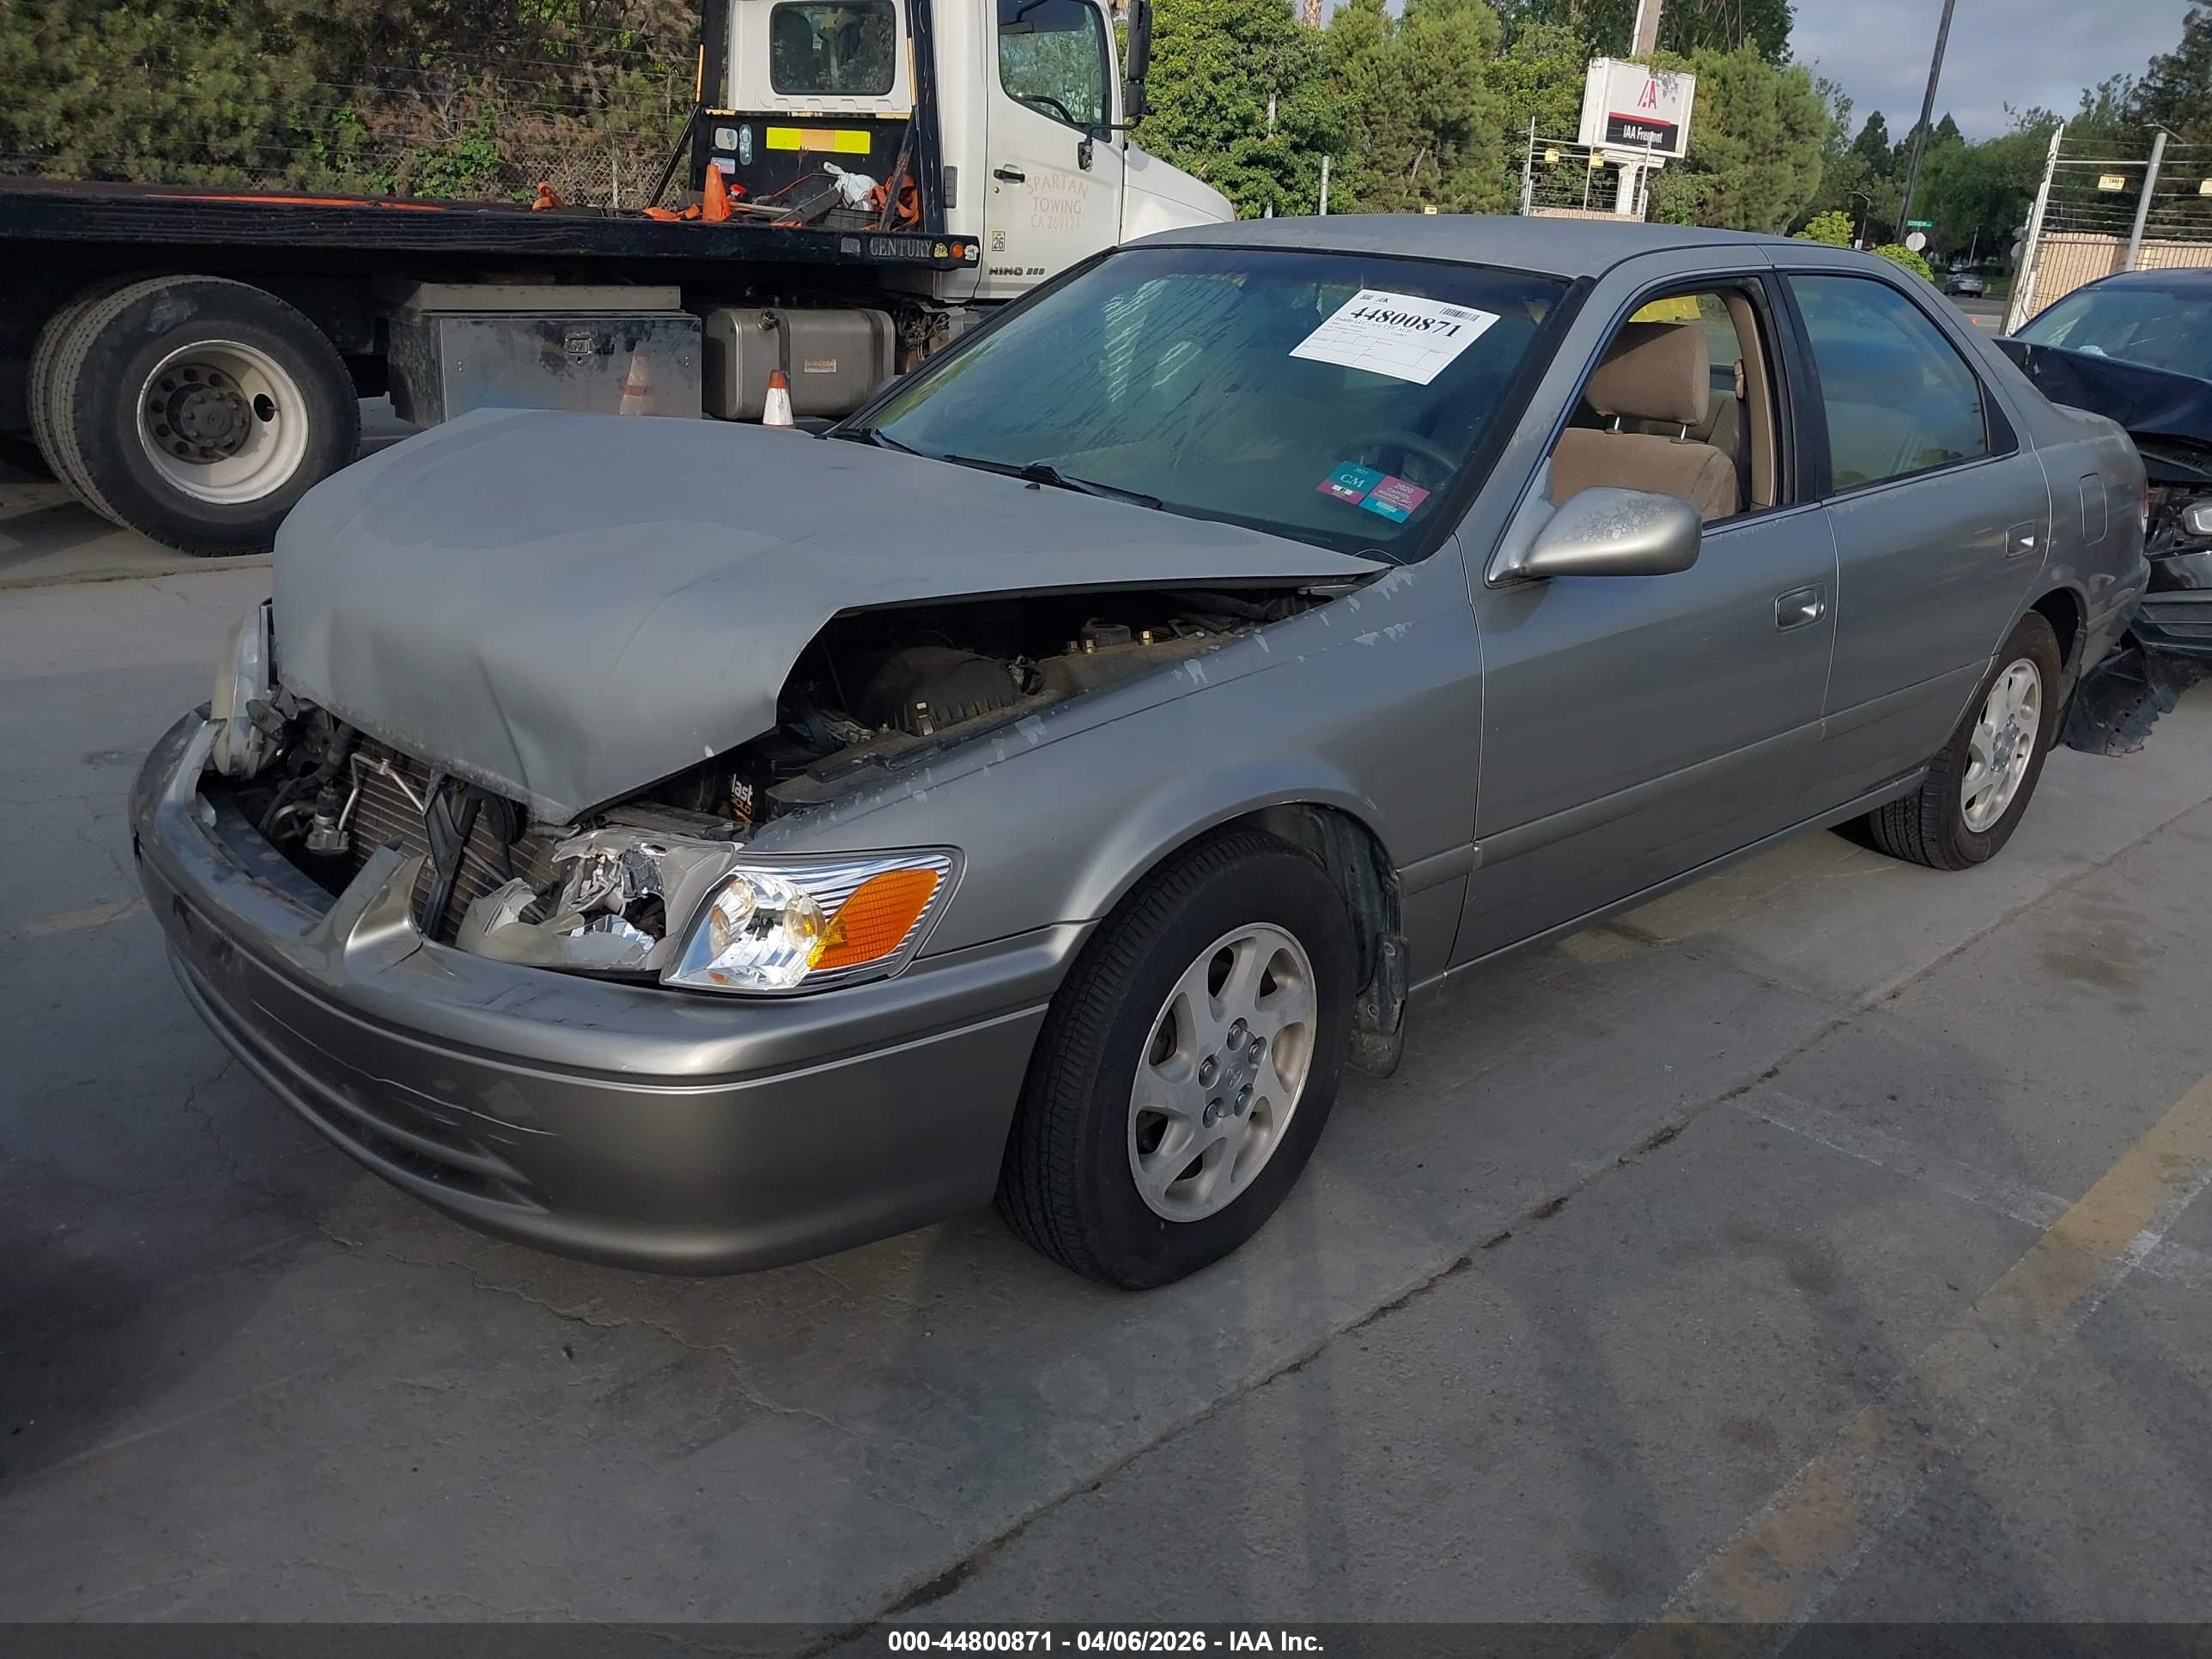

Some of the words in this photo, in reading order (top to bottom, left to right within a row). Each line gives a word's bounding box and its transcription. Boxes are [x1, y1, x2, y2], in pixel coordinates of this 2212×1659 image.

[1622, 125, 1636, 140] IAA
[1025, 173, 1089, 199] SPARTAN
[1033, 196, 1082, 215] TOWING
[1031, 214, 1044, 228] CA
[869, 237, 933, 258] CENTURY
[994, 236, 1004, 250] 26
[988, 266, 1024, 276] HINO
[1350, 307, 1463, 338] 44800871
